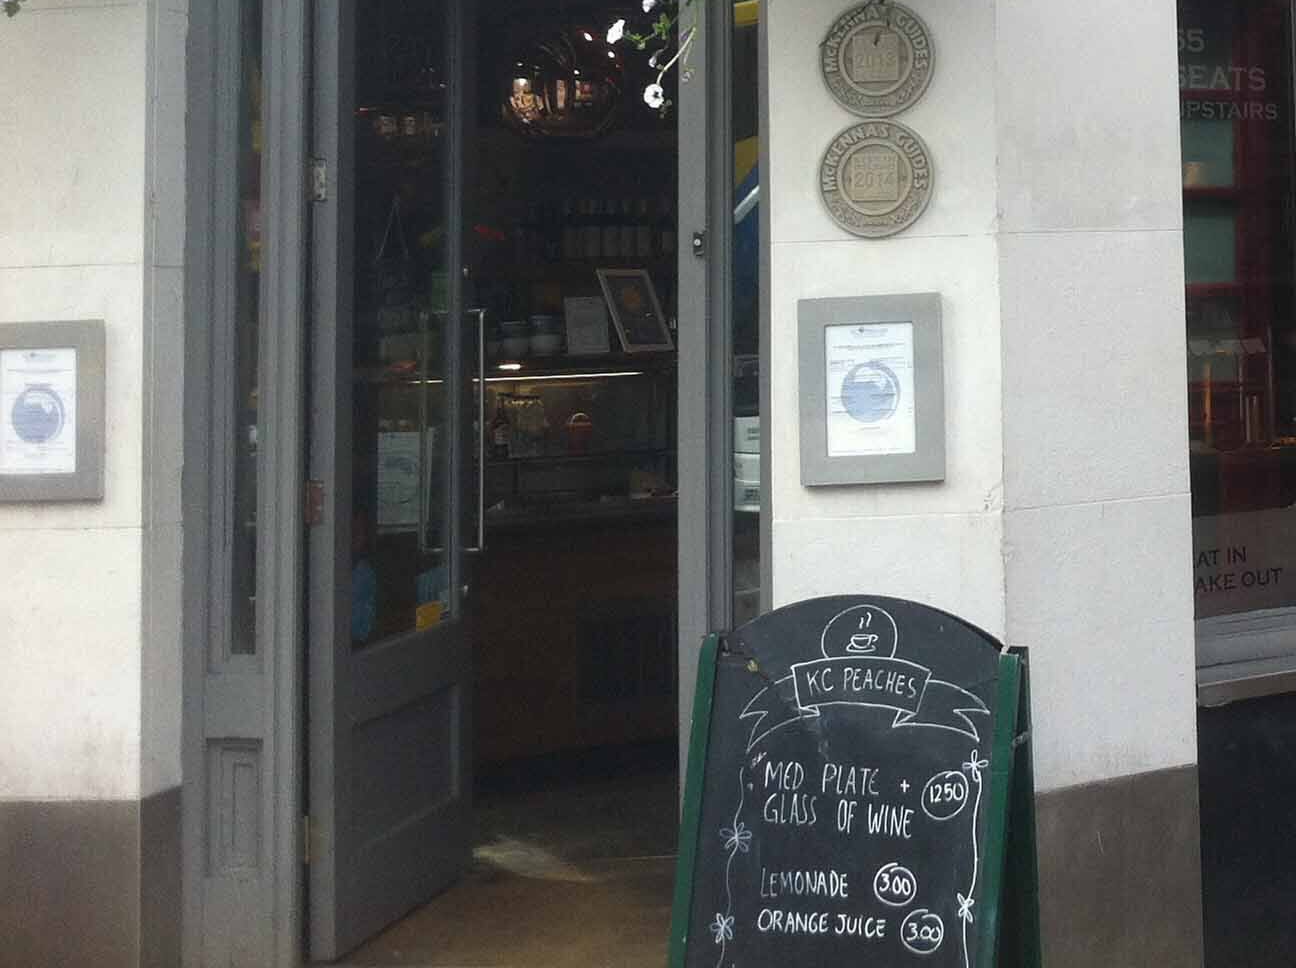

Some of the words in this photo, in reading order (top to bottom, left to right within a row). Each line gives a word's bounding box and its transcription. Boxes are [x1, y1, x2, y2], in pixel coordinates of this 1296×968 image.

[895, 14, 930, 71] GUIDES
[1181, 101, 1279, 120] PSTAIRS
[894, 130, 931, 190] GUIDES
[1226, 545, 1247, 565] IN
[1195, 573, 1237, 592] AKE
[1241, 567, 1283, 588] OUT
[806, 668, 834, 692] KC
[843, 667, 917, 698] PEACHES
[764, 761, 805, 790] MED
[822, 763, 880, 796] PLATE
[763, 792, 817, 825] GLASS
[837, 799, 858, 834] OF
[868, 803, 915, 839] WINE
[760, 867, 849, 898] LEMONADE
[879, 873, 912, 896] 3.00
[757, 908, 829, 934] ORANGE
[834, 913, 887, 939] JUICE
